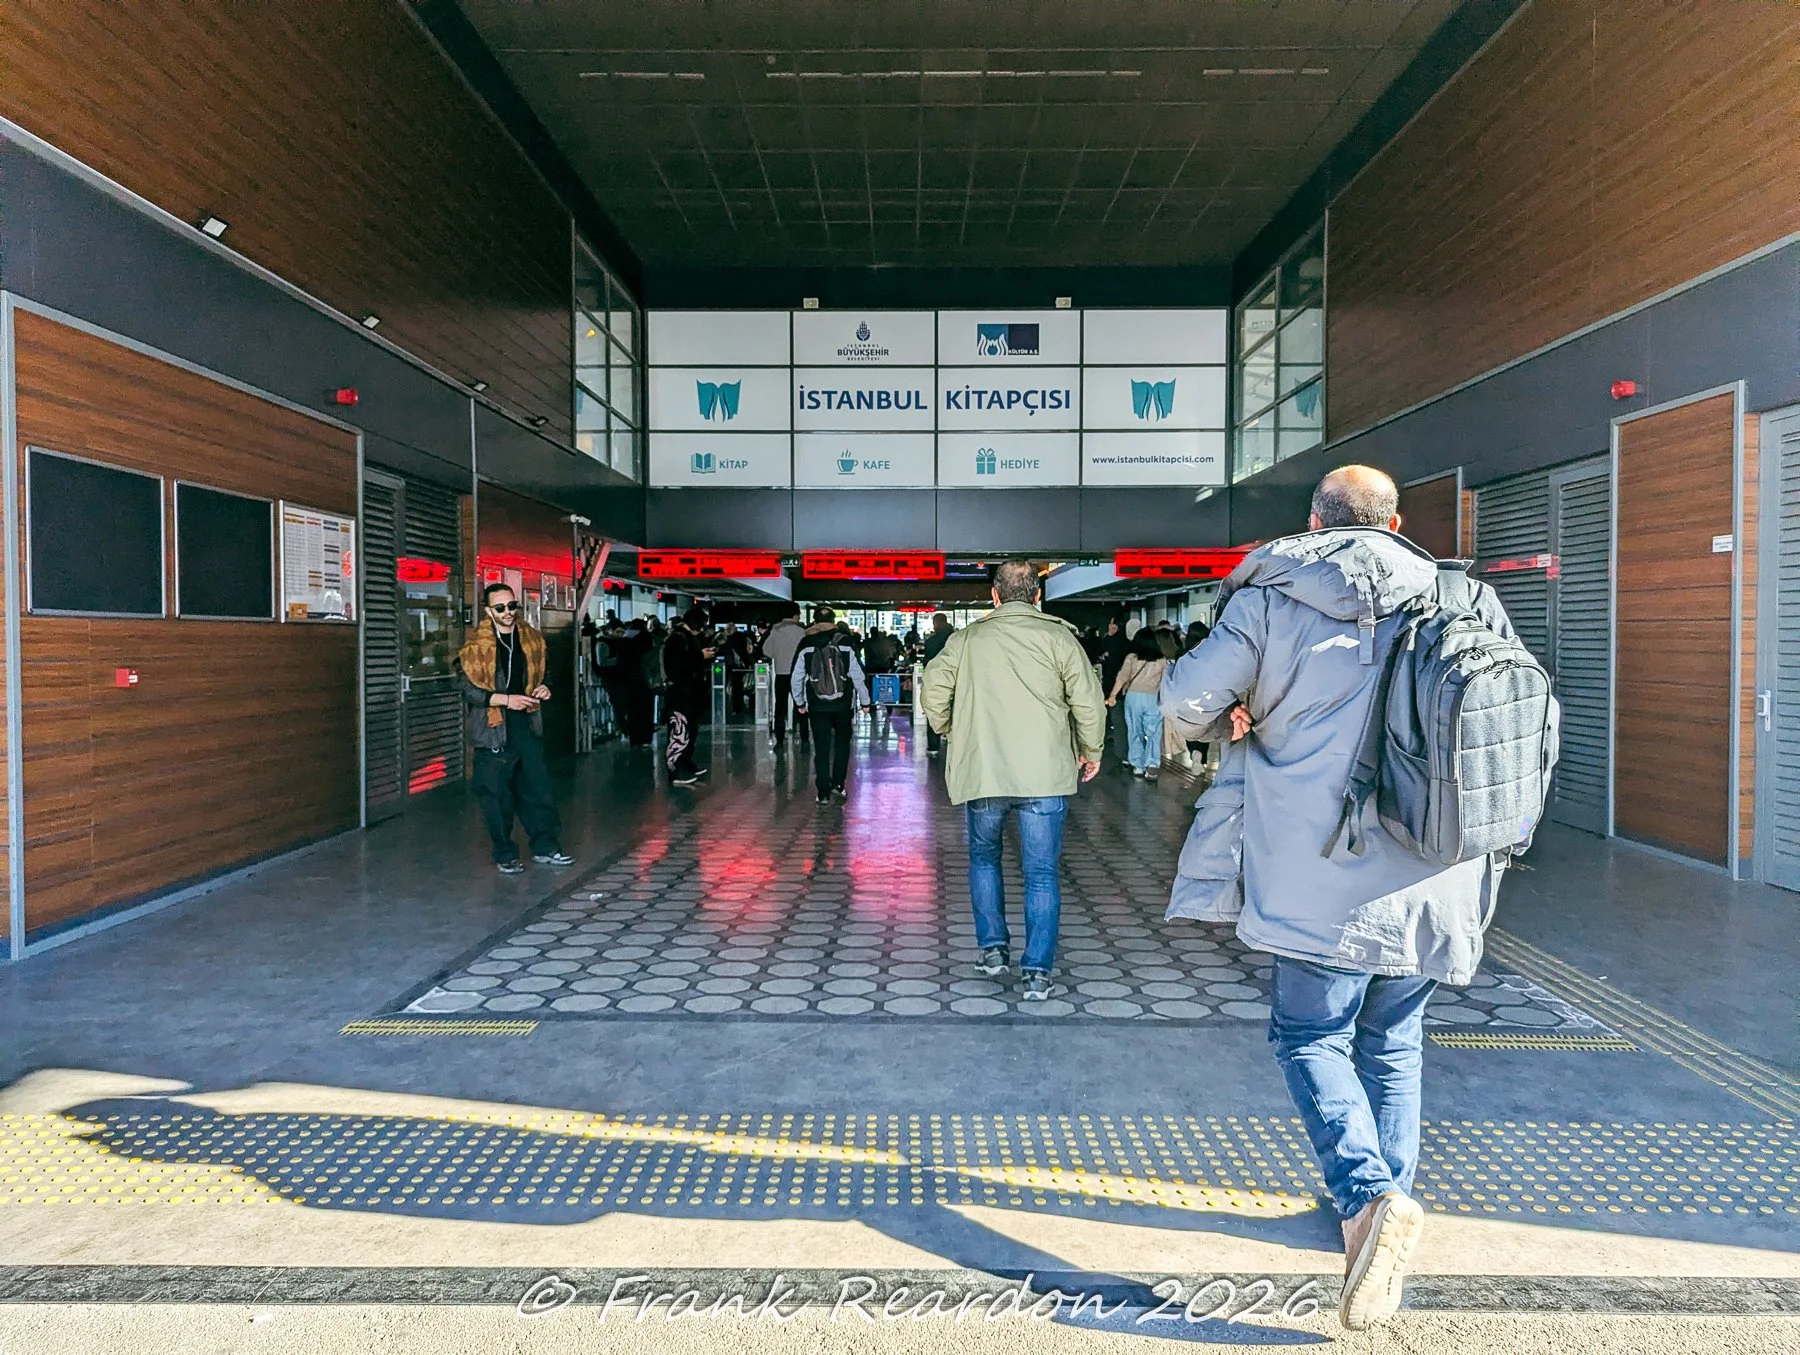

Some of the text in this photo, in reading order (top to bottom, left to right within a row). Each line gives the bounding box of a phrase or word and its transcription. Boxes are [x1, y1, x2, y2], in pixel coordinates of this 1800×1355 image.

[837, 347, 889, 358] BÜYÜKŞEHİR
[799, 384, 1071, 417] İSTANBUL KİTAPÇISI
[719, 458, 748, 469] KİTAP
[863, 460, 891, 470] KAFE
[1000, 457, 1040, 469] HEDİYE
[1092, 455, 1214, 465] www.istanbulkitapcisi.com
